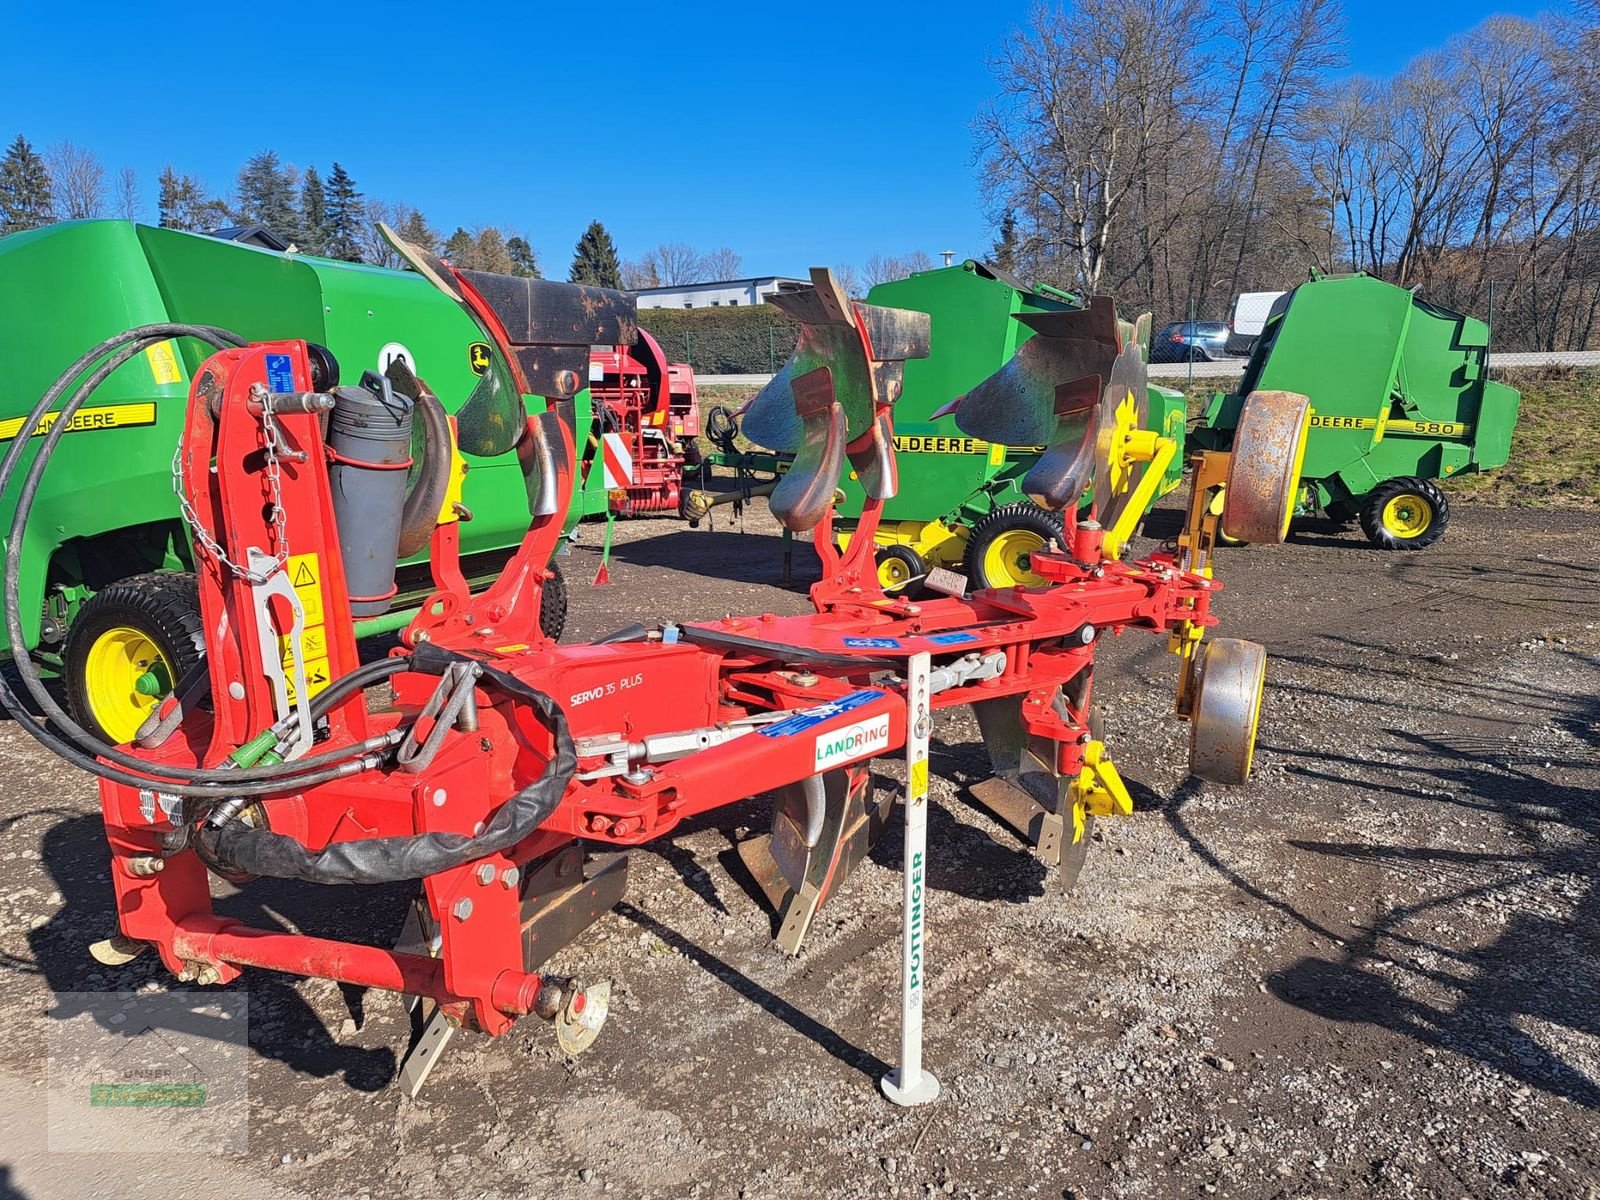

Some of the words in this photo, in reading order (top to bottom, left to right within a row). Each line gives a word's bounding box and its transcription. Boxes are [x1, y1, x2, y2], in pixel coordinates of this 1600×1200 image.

[1310, 416, 1363, 428] DEERE
[1414, 422, 1454, 435] 580
[908, 437, 974, 454] DEERE
[570, 686, 604, 707] SERVO
[605, 682, 616, 696] 35
[620, 672, 643, 691] PLUS
[816, 724, 888, 761] LANDRING
